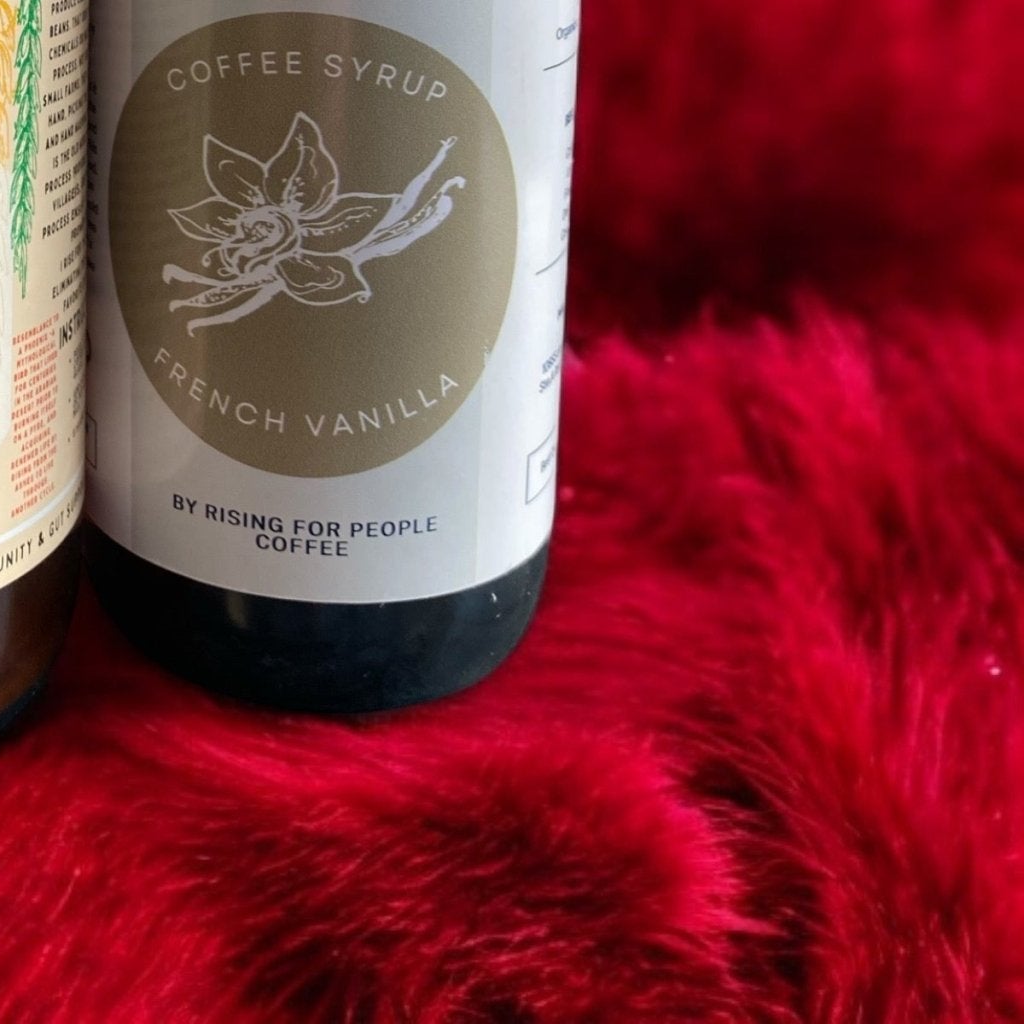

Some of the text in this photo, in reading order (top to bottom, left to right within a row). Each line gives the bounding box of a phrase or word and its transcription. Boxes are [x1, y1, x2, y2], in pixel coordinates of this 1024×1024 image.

[167, 51, 448, 103] COFFEE SYRUP
[42, 87, 62, 107] SMALL
[45, 132, 58, 150] AND
[52, 155, 58, 168] IS
[60, 147, 69, 164] THE
[44, 169, 71, 194] PROCESS
[42, 211, 69, 240] PROCESS
[153, 347, 285, 434] FRENCH
[304, 373, 459, 437] VANILLA
[38, 532, 44, 546] &
[49, 510, 65, 537] GUT
[173, 494, 438, 538] BY RISING FOR PEOPLE
[255, 534, 348, 556] COFFEE
